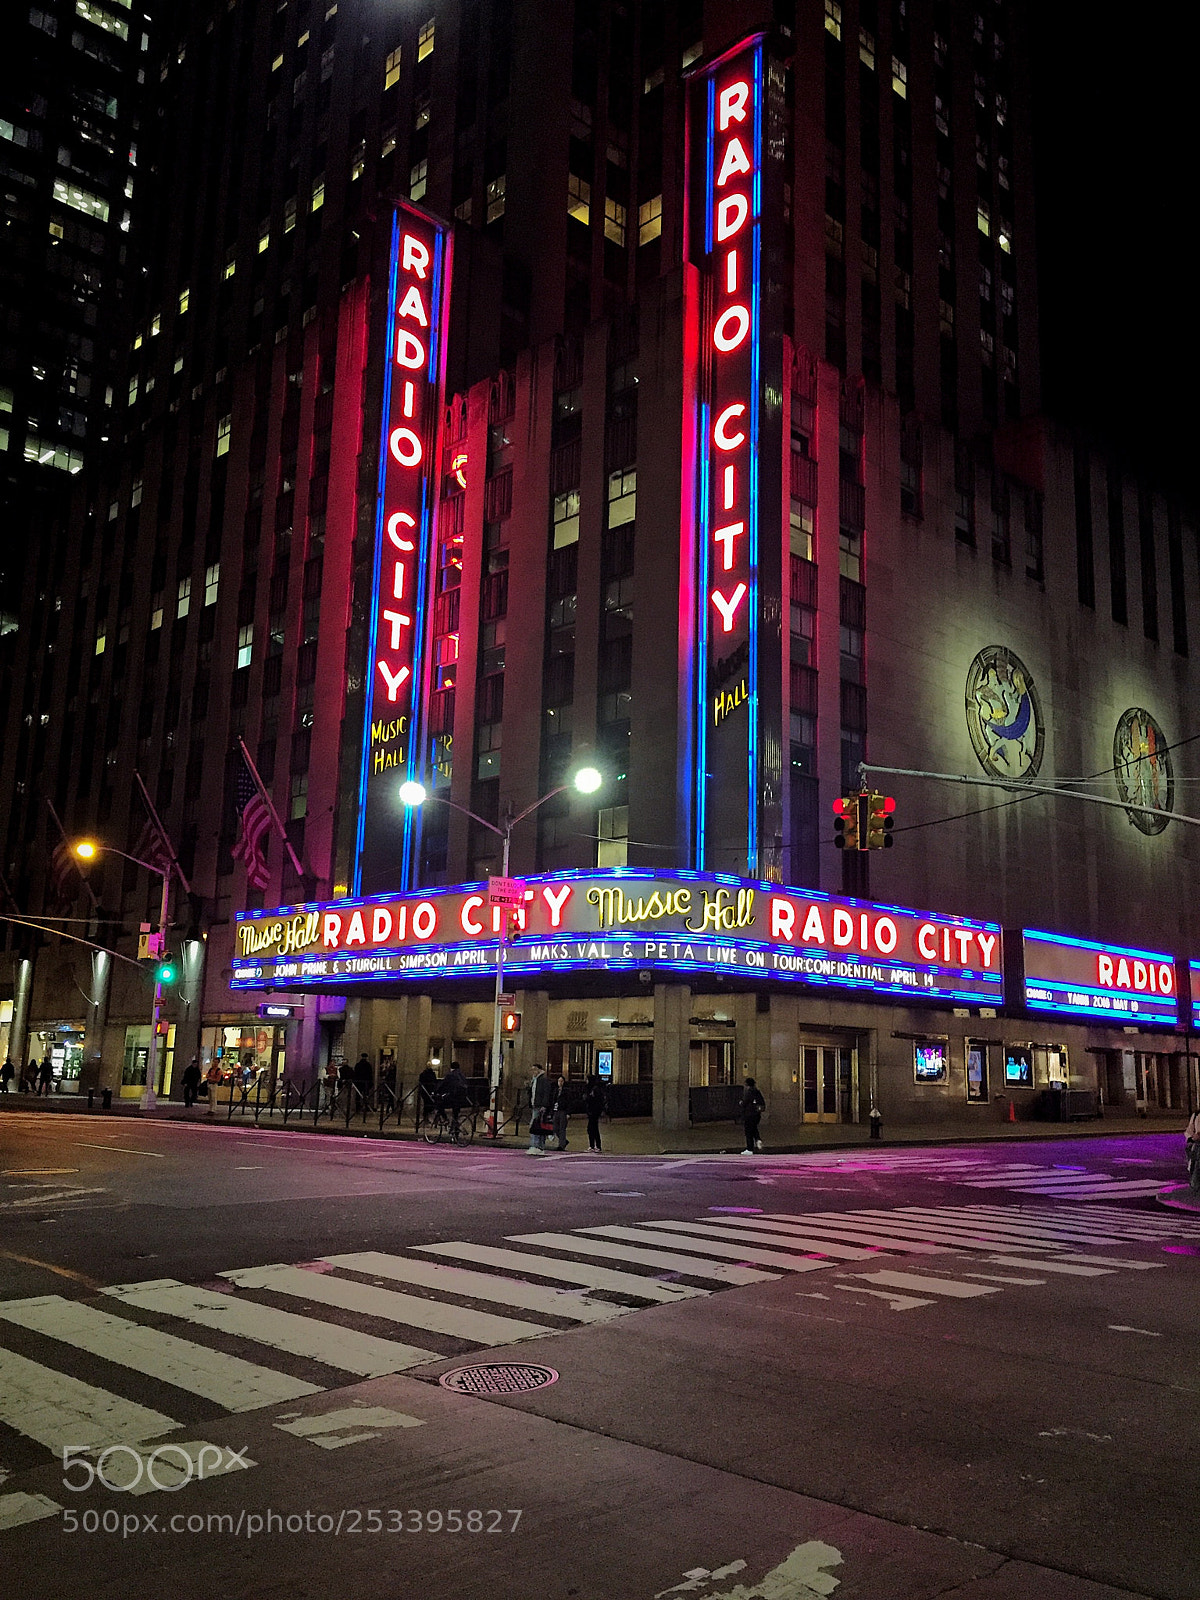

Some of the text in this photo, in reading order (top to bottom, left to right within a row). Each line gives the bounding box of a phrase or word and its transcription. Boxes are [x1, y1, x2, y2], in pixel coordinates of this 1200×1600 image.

[712, 80, 751, 353] RADIO
[377, 234, 429, 702] RADIO CITY
[710, 402, 748, 633] CITY
[714, 679, 749, 727] HALL
[371, 715, 407, 747] MUSIC
[374, 746, 405, 776] HALL
[277, 910, 320, 956] Hall
[323, 884, 572, 948] RADIO CITY
[586, 886, 756, 933] Music Hall
[771, 897, 995, 967] RADIO CITY
[273, 963, 298, 978] JOHN
[345, 956, 393, 974] STURGILL
[399, 951, 448, 970] SIMPSON
[453, 949, 488, 966] APRIL
[577, 942, 611, 959] VAL
[645, 942, 695, 960] PETA
[706, 946, 737, 965] LIVE
[745, 950, 765, 967] ON
[890, 970, 919, 986] APRIL
[1098, 954, 1173, 994] RADIO
